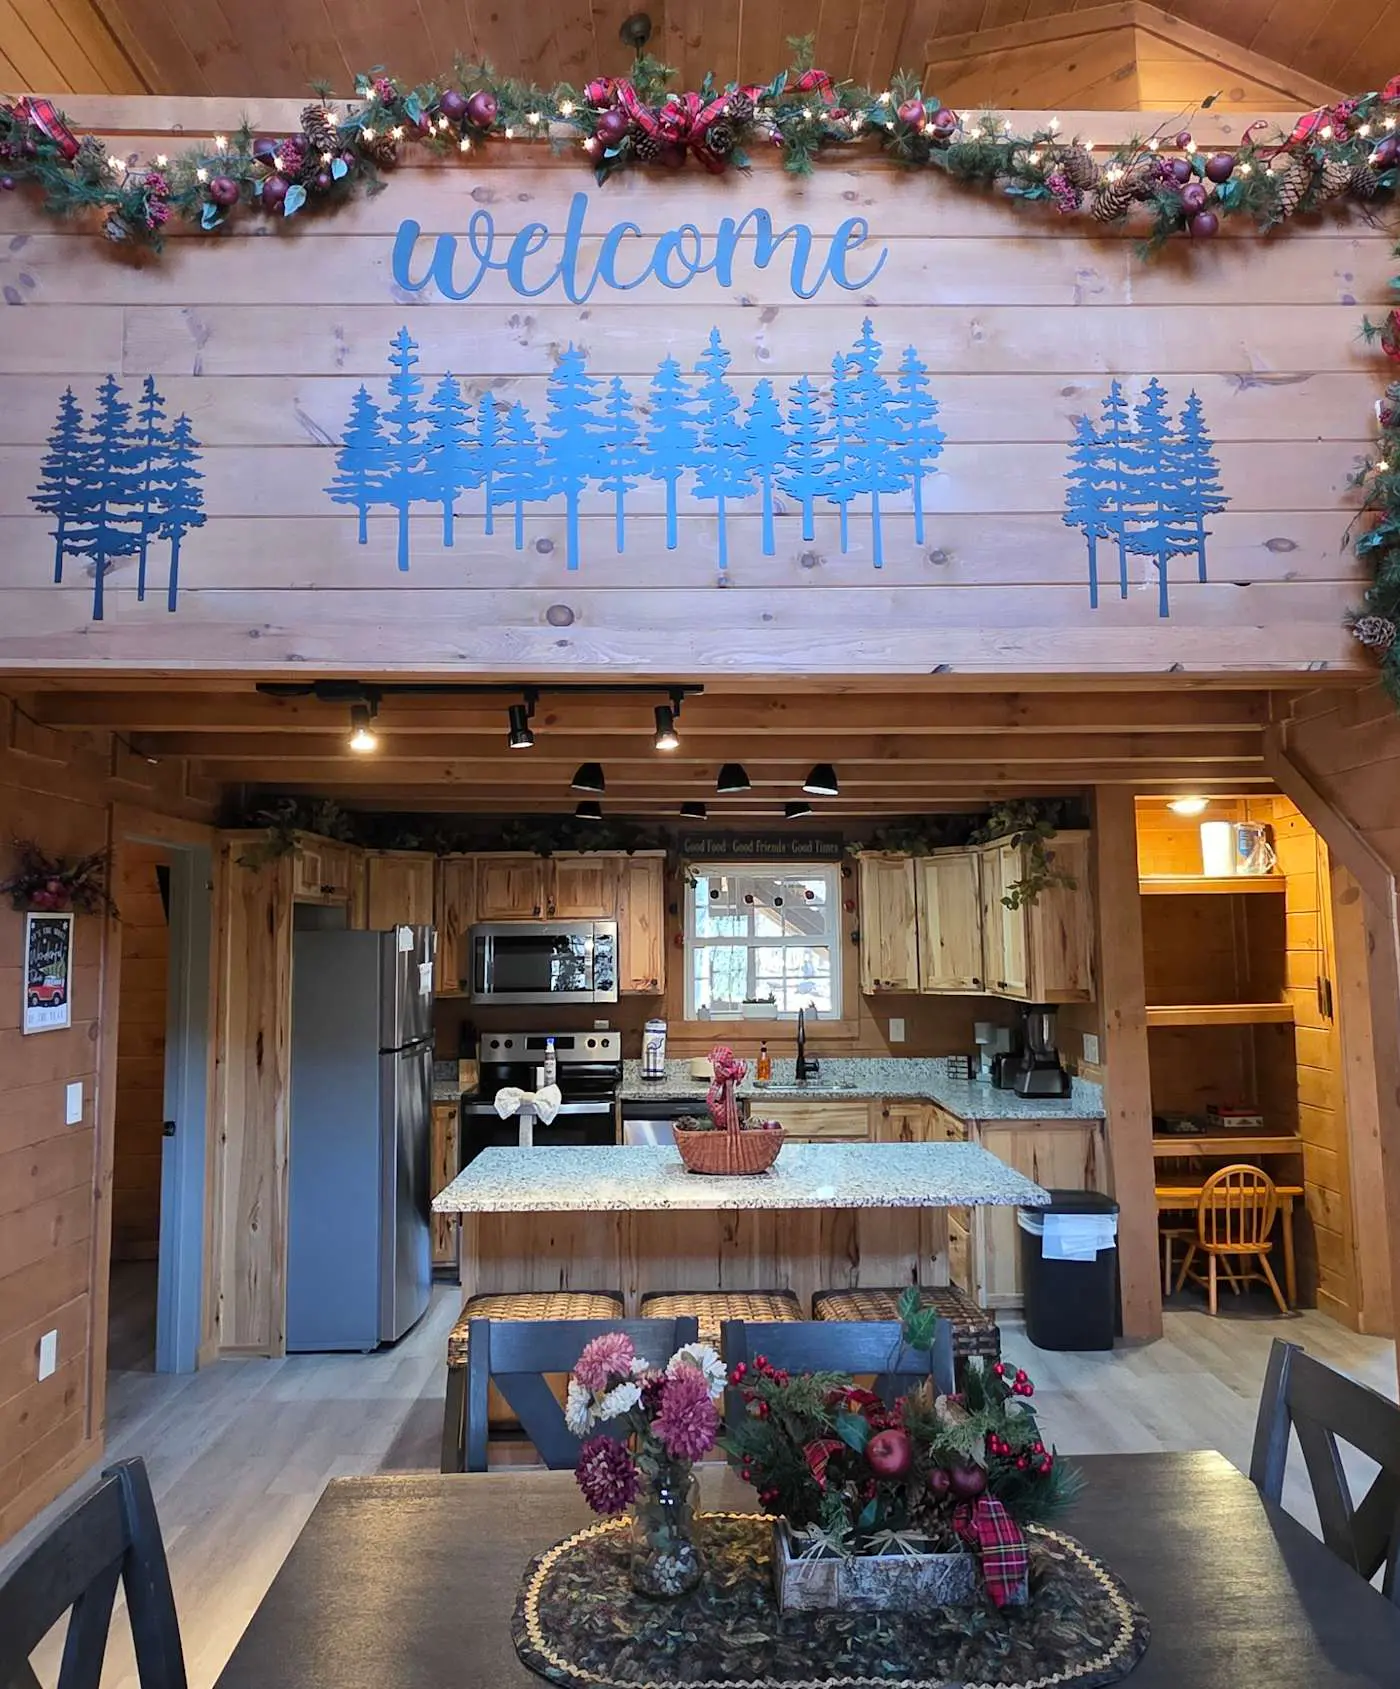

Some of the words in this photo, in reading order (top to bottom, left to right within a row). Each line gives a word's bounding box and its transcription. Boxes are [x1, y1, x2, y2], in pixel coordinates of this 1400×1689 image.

[392, 192, 888, 304] welcome
[684, 838, 705, 853] Good
[732, 838, 754, 853] Good
[791, 838, 813, 853] Good
